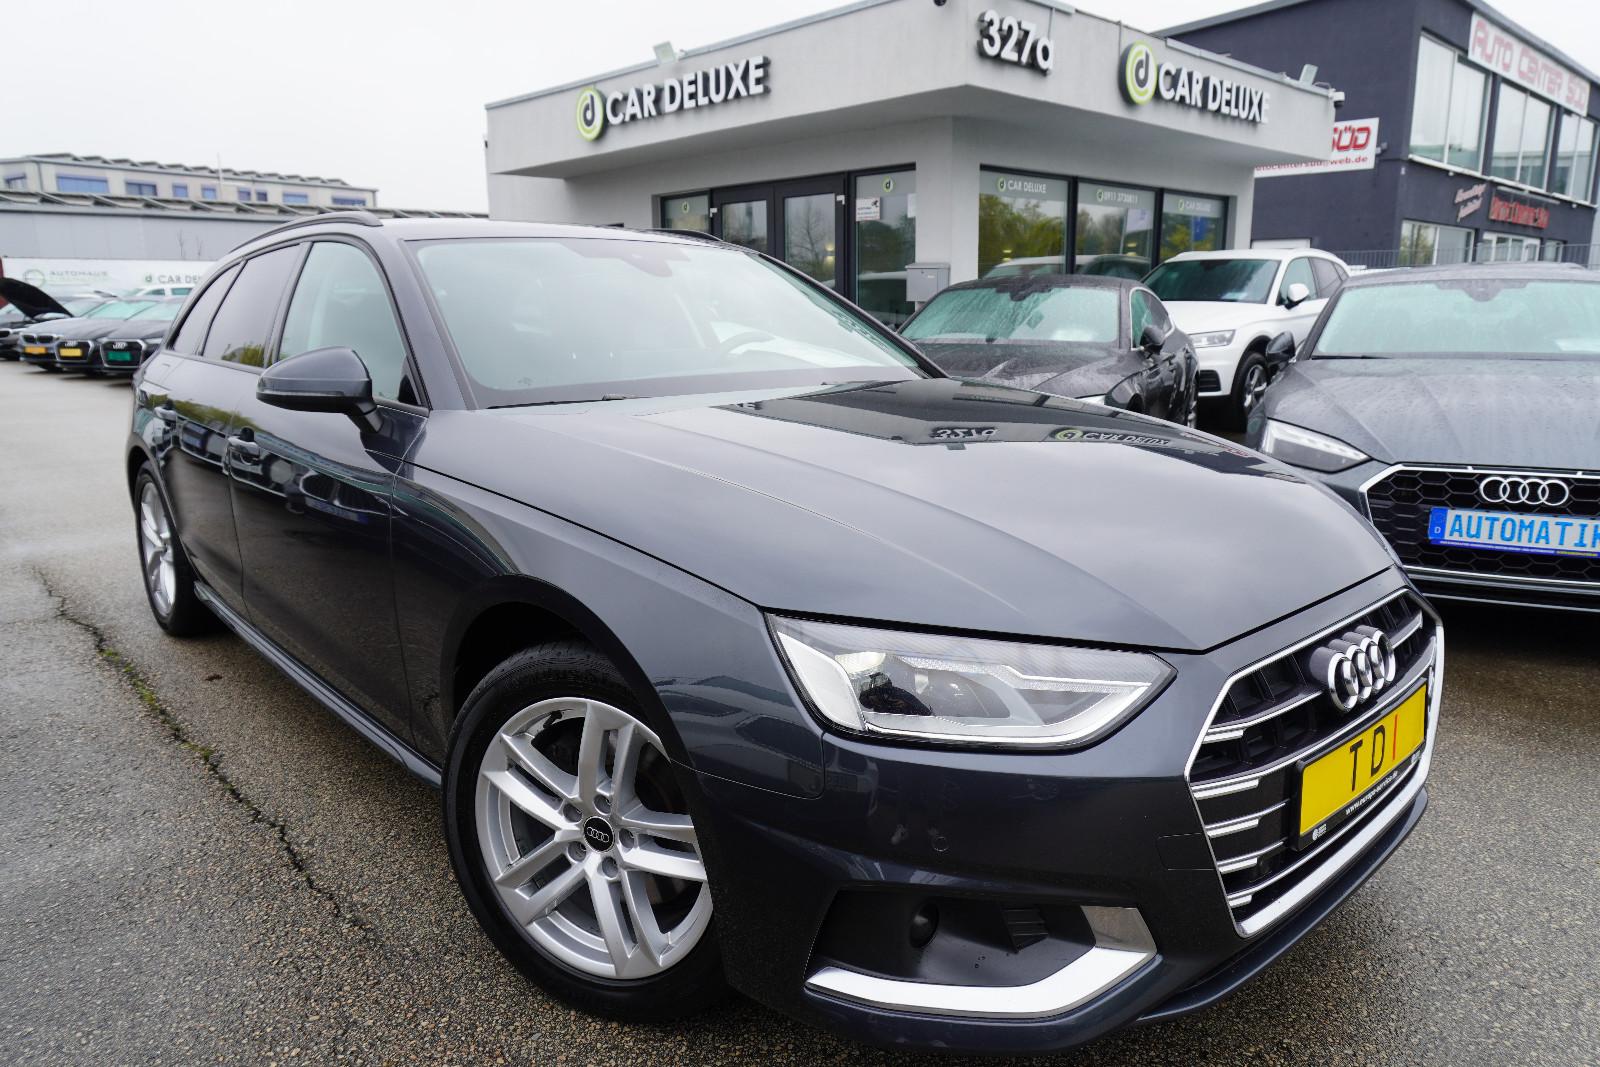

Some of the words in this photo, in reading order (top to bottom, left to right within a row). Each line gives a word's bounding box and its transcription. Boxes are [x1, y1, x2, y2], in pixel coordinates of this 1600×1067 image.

[979, 9, 1054, 73] 327a
[605, 82, 658, 126] CAR
[664, 55, 767, 114] DELUXE
[1158, 61, 1203, 108] CAR
[1207, 74, 1270, 123] DELUXE
[1007, 180, 1022, 191] CAR
[1023, 181, 1047, 194] DELUXE
[159, 274, 182, 284] CAR
